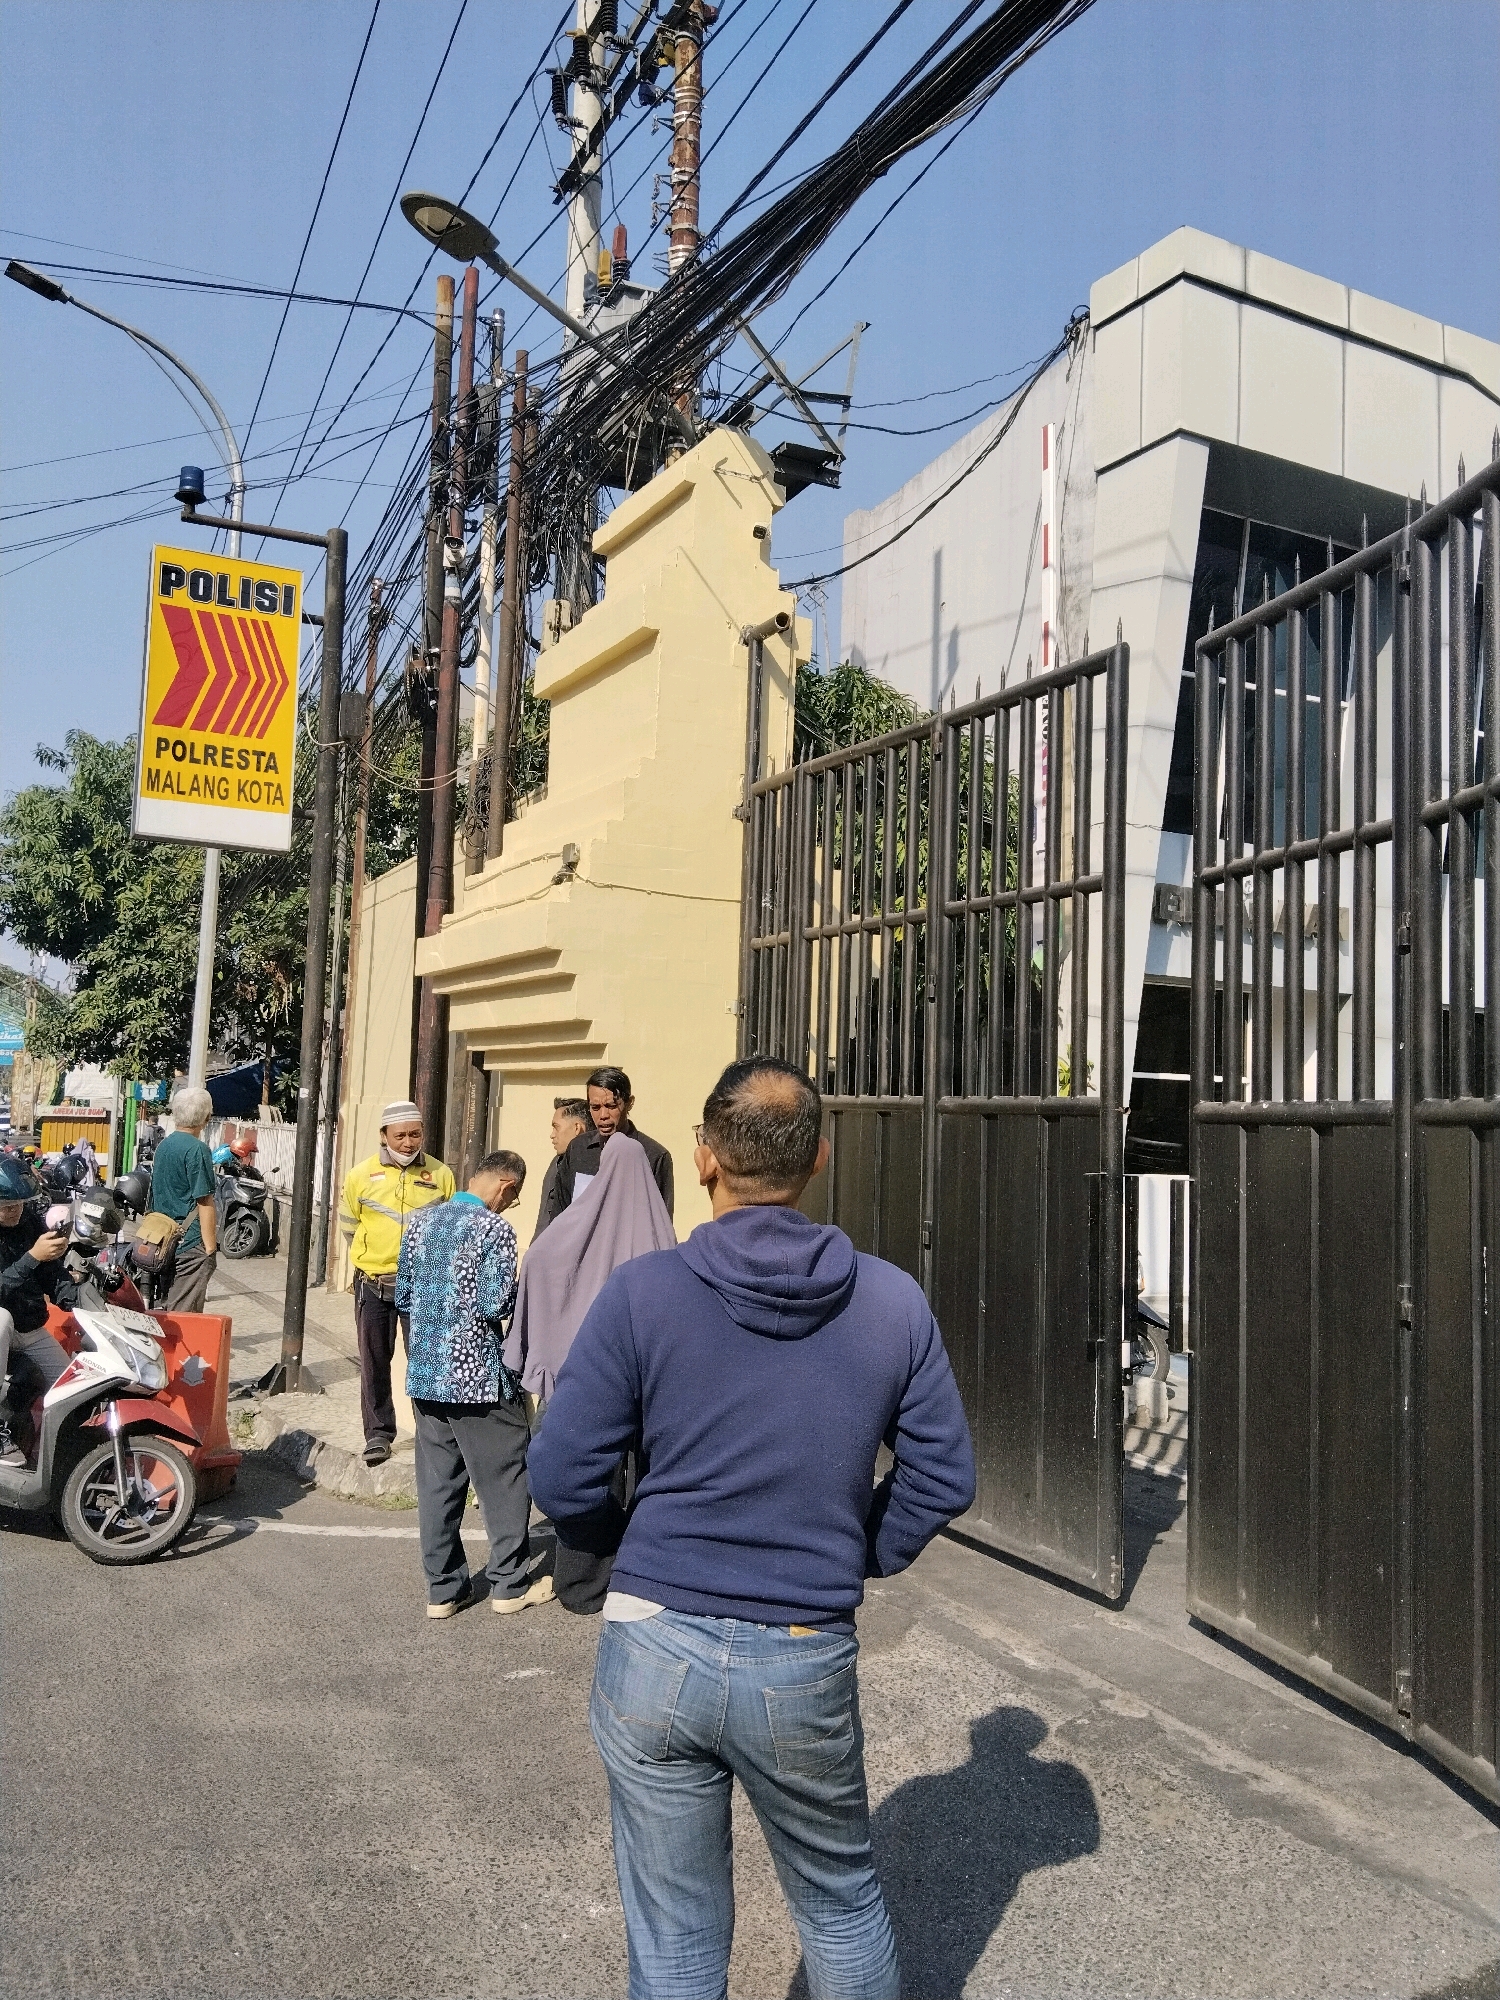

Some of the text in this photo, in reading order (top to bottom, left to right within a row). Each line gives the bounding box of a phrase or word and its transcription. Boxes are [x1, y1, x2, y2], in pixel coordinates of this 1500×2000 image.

[159, 562, 296, 618] POLISI
[156, 737, 280, 775] POLRESTA
[146, 767, 285, 807] MALANG KOTA
[82, 1356, 107, 1374] HONDA
